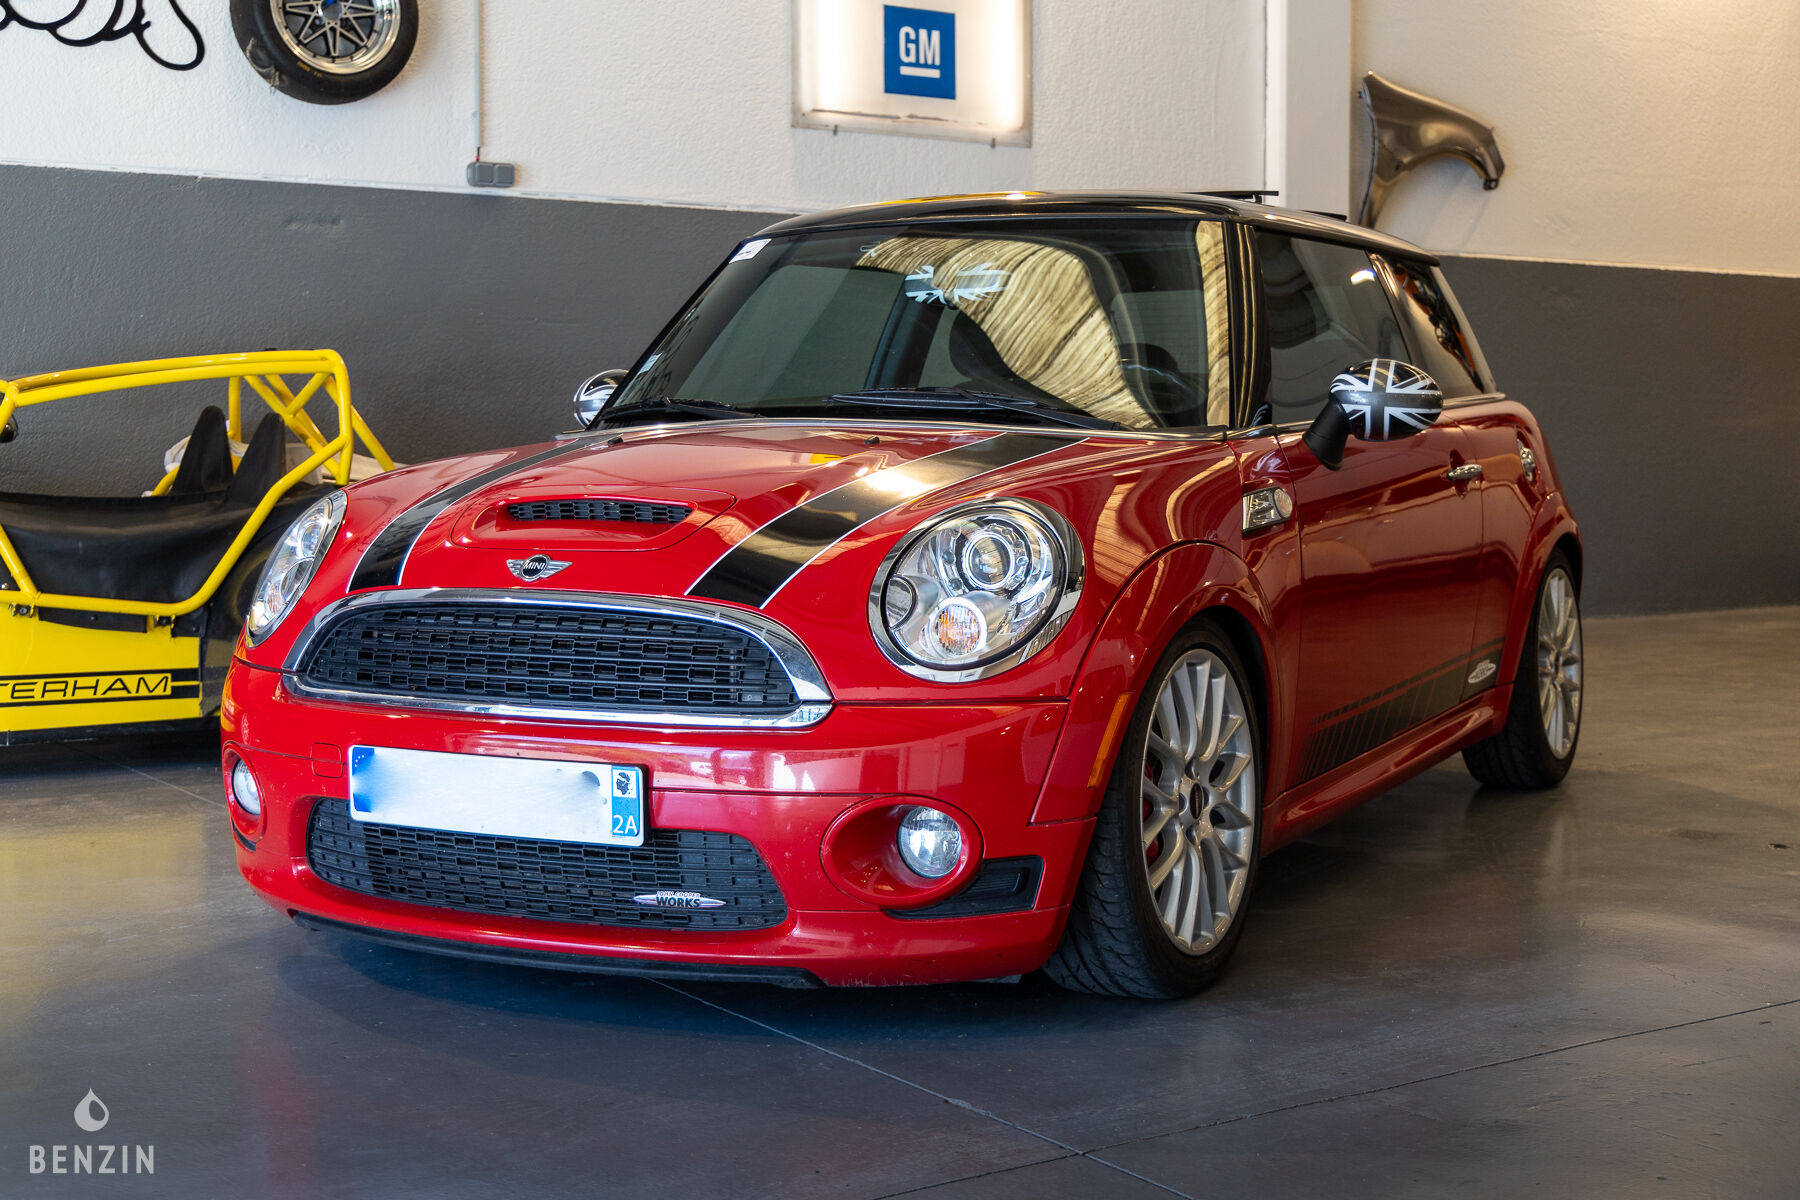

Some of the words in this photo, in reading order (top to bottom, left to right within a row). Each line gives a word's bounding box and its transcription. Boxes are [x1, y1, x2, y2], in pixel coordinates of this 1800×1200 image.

[899, 26, 940, 66] GM
[523, 561, 546, 570] MINI
[613, 814, 638, 835] 2A
[656, 897, 701, 908] WORKS
